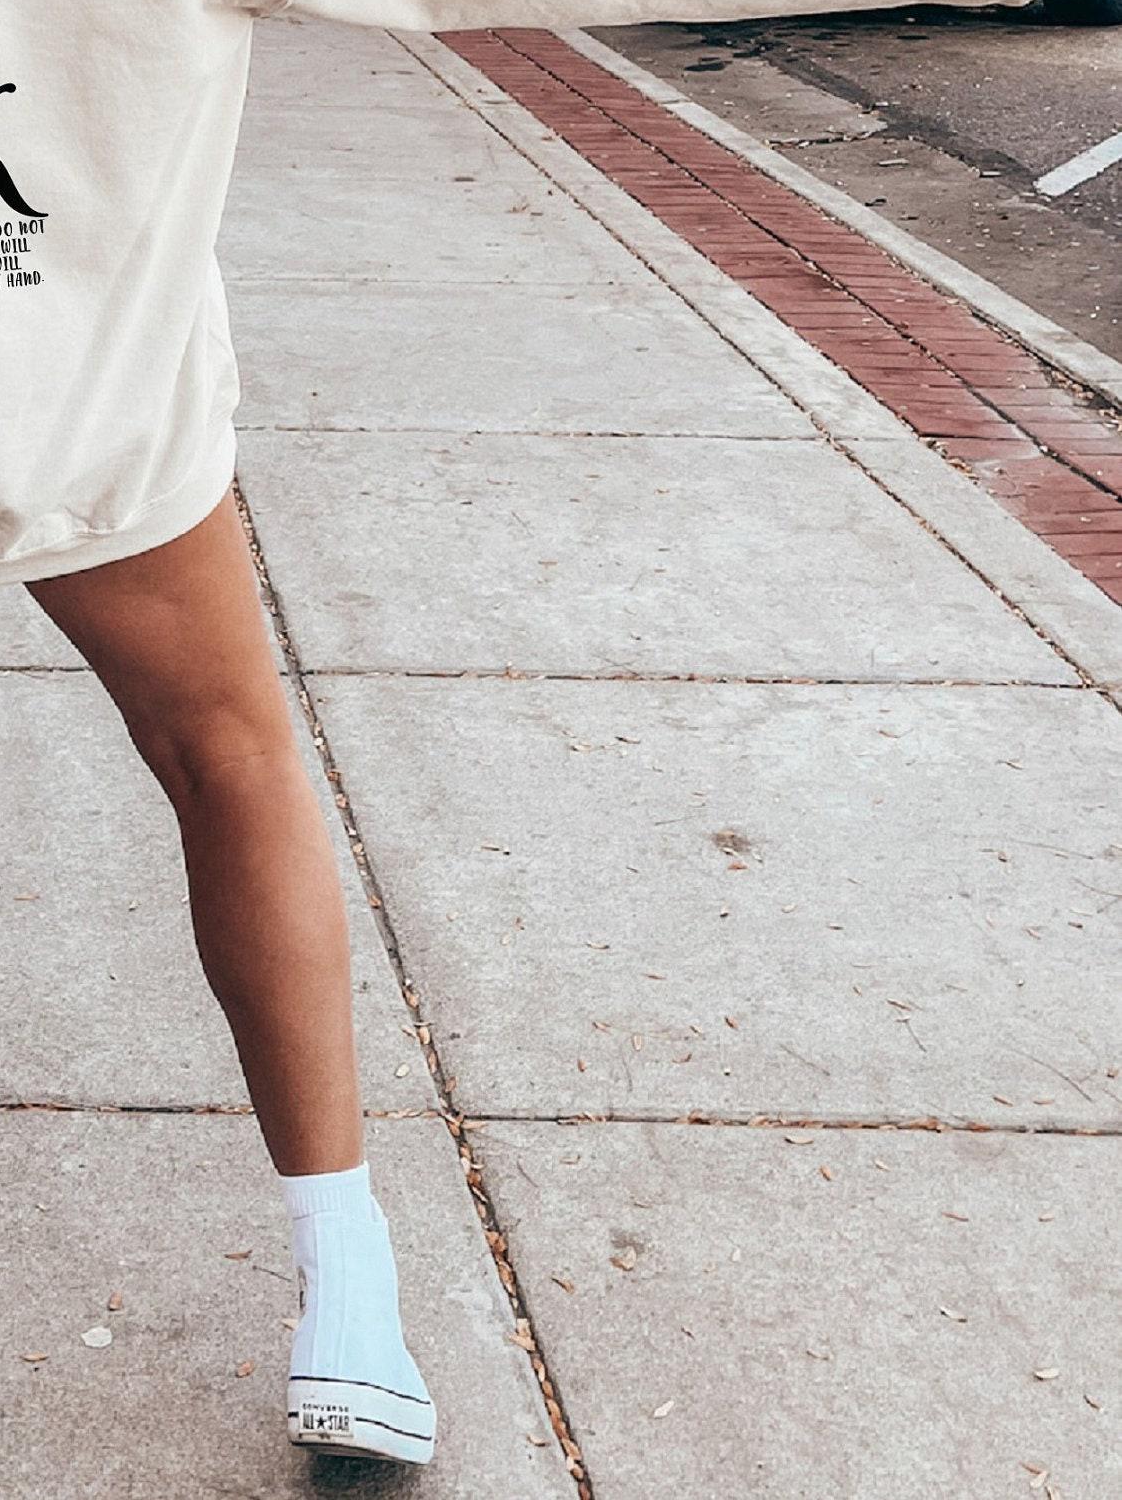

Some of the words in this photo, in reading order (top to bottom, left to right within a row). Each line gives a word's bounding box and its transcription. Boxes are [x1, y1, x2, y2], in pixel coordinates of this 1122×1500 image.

[19, 219, 45, 236] NOT
[0, 237, 31, 254] WILL
[329, 1414, 349, 1431] STAR
